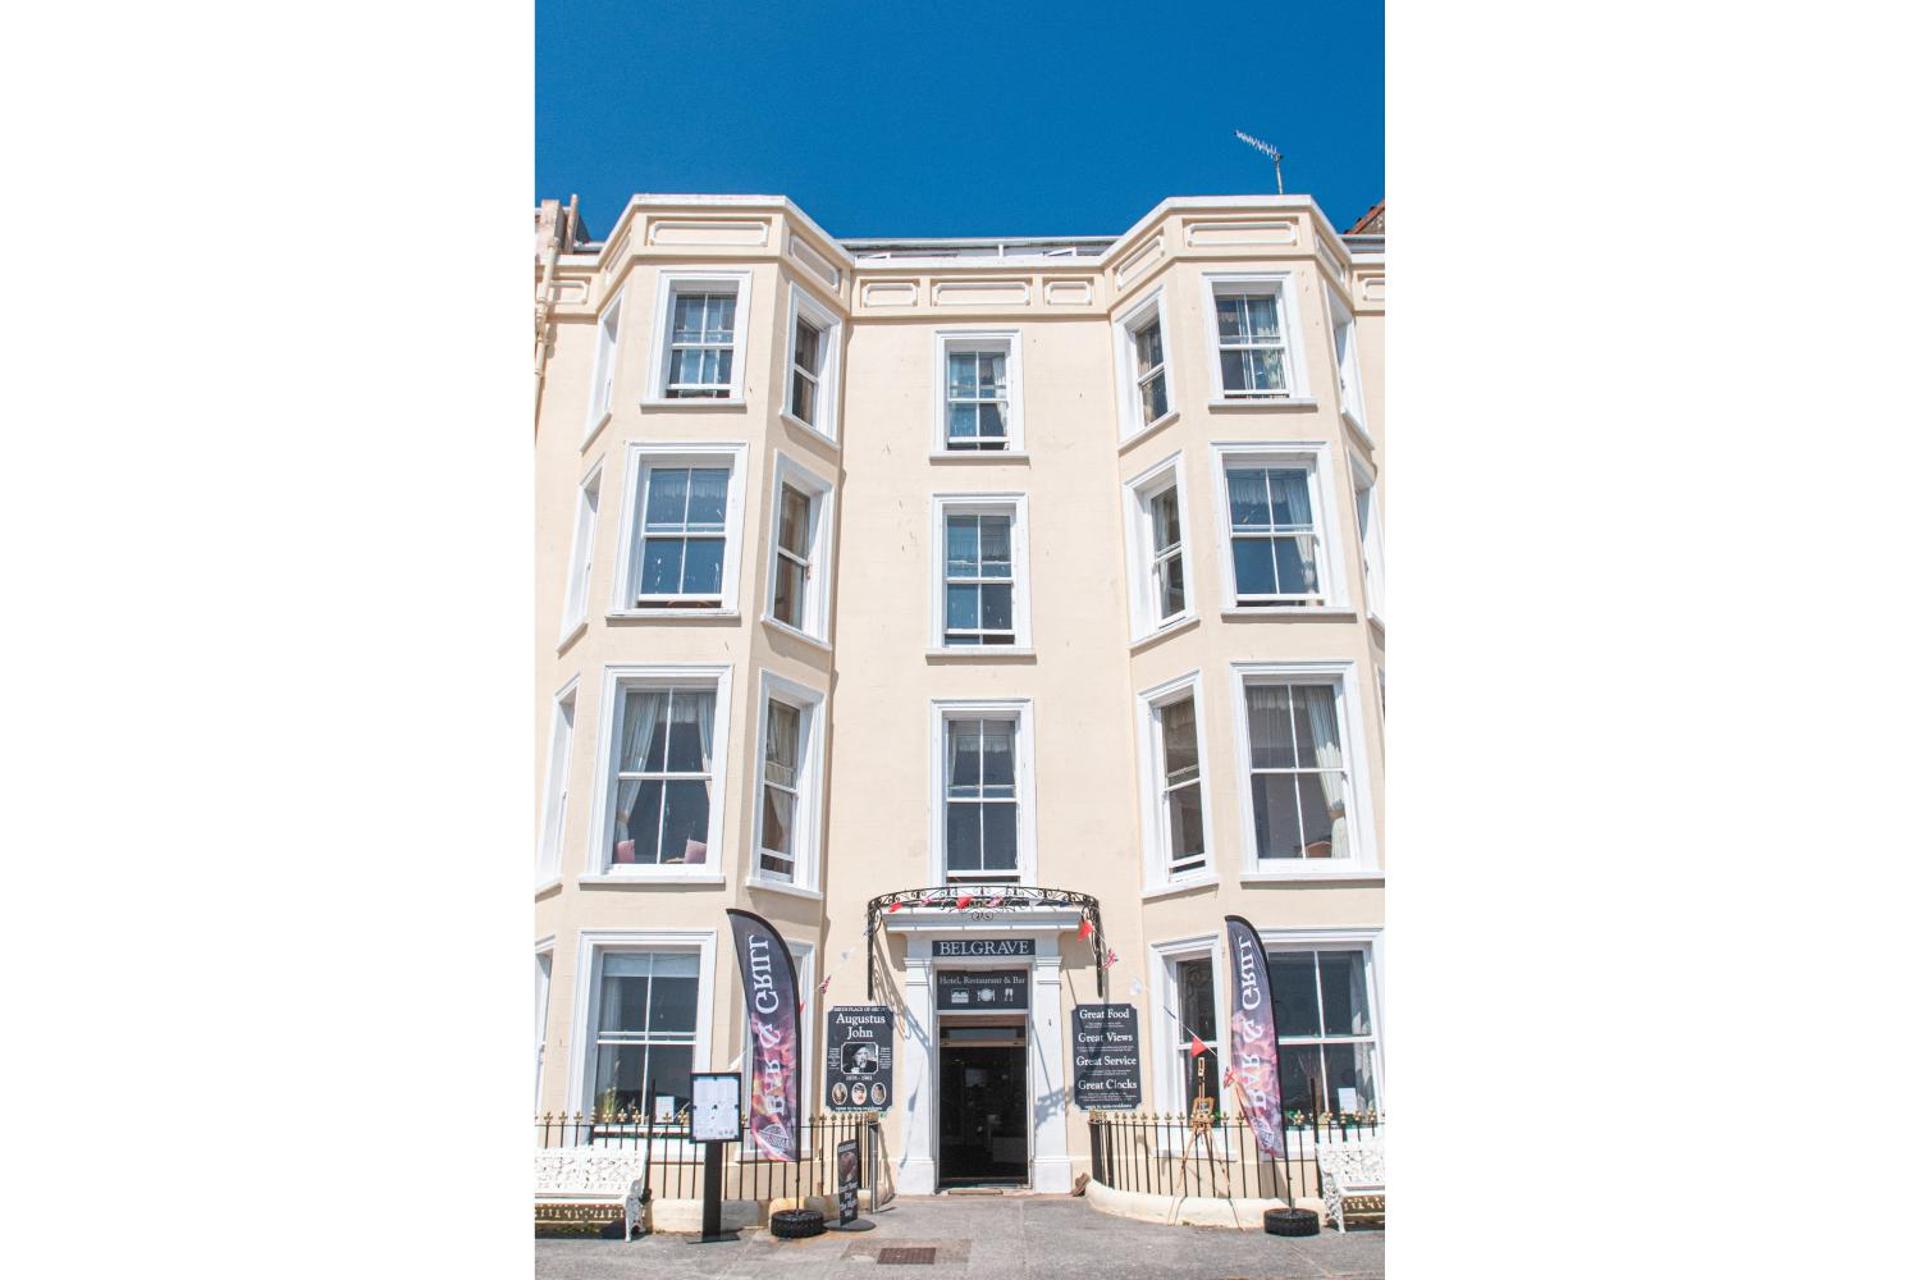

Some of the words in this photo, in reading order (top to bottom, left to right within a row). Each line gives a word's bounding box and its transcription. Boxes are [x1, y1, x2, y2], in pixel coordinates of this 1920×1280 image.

[940, 941, 1029, 955] BELGRAVE
[963, 976, 1002, 985] Restaurant
[1003, 976, 1011, 984] &
[1013, 976, 1025, 984] Bar
[836, 1013, 886, 1026] Augustus
[1079, 1009, 1105, 1019] Great
[1107, 1008, 1130, 1019] Food
[847, 1026, 873, 1040] John
[1078, 1032, 1104, 1043] Great
[1106, 1031, 1134, 1042] Views
[1076, 1056, 1103, 1066] Great
[1104, 1055, 1137, 1066] Service
[1078, 1079, 1104, 1090] Great
[1106, 1078, 1137, 1090] Clocks
